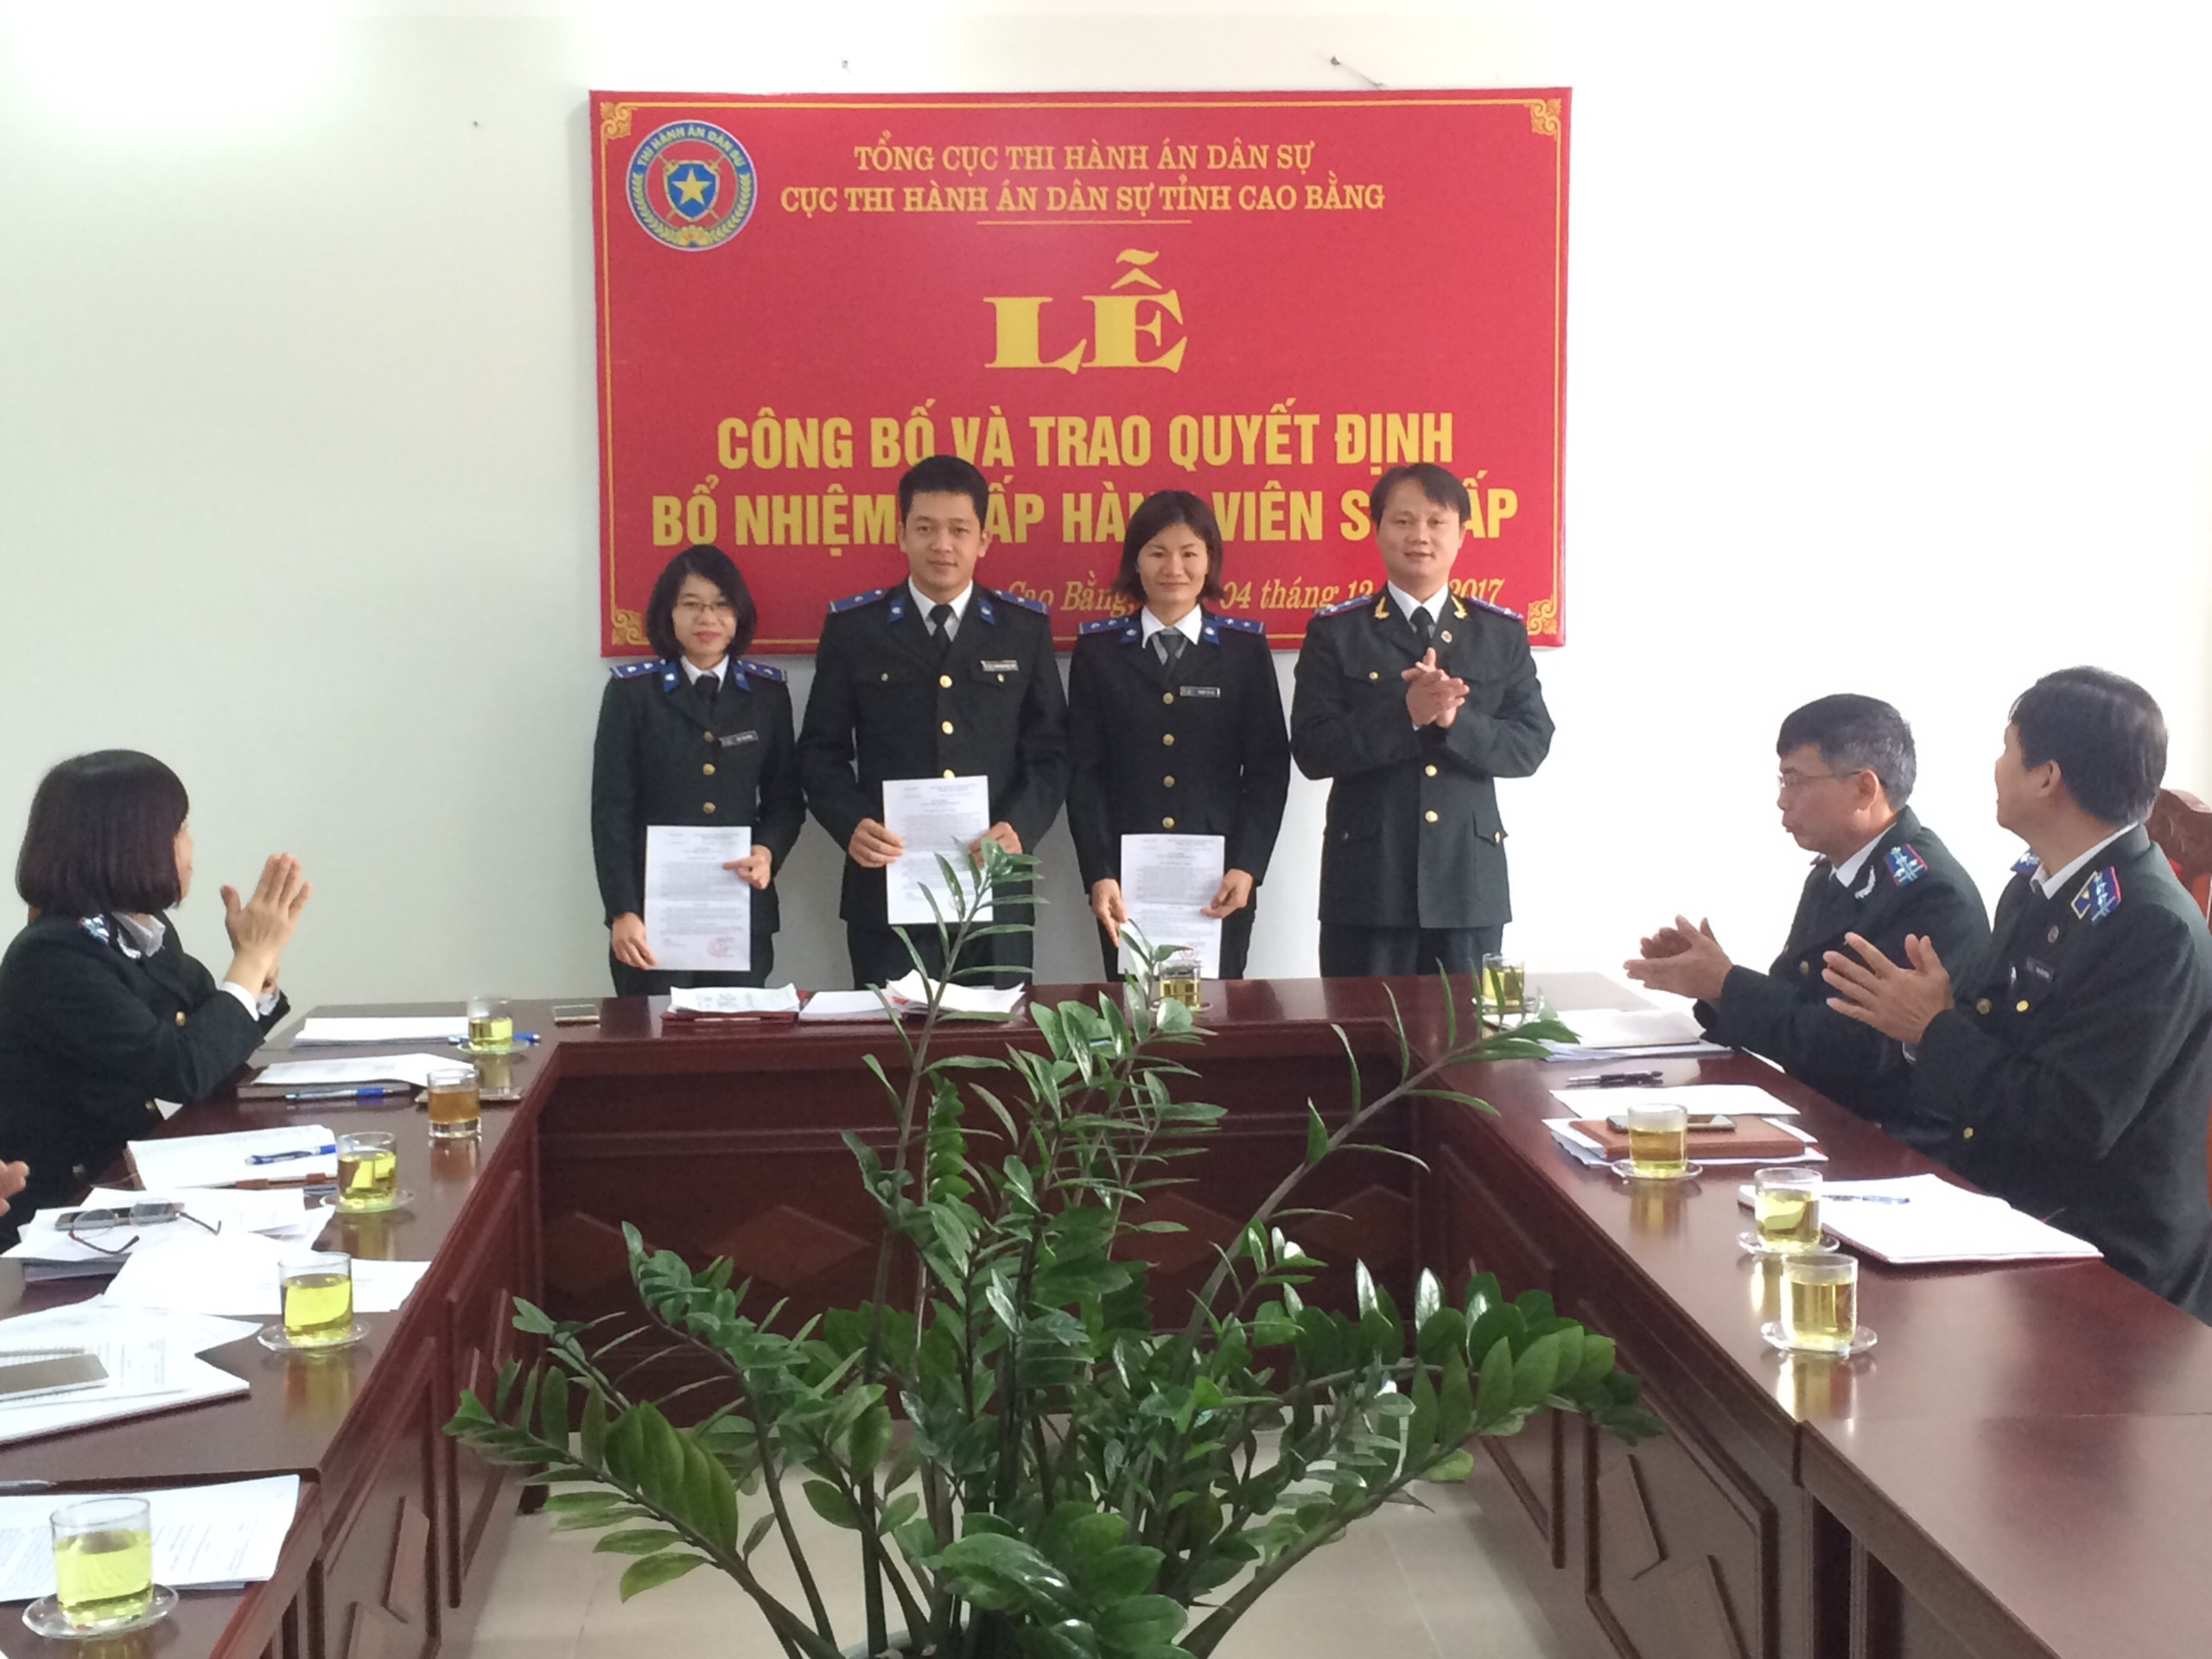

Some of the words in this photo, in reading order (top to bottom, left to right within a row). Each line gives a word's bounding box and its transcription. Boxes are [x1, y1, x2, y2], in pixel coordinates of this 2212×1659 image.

[638, 146, 654, 165] THI
[854, 130, 935, 171] TỔNG
[943, 145, 998, 176] CỤC
[1005, 145, 1055, 170] THI
[1064, 138, 1148, 170] HÀNH
[1158, 137, 1198, 169] ÁN
[1207, 137, 1268, 169] DÂN
[1277, 140, 1315, 175] SỰ
[781, 187, 837, 218] CỤC
[844, 187, 894, 212] THI
[903, 179, 988, 212] HÀNH
[996, 179, 1038, 212] ÁN
[1046, 178, 1108, 211] DÂN
[1116, 181, 1155, 217] SỰ
[1159, 174, 1231, 211] TỈNH
[1238, 185, 1296, 210] CAO
[1305, 170, 1385, 210] BẰNG
[982, 248, 1187, 375] LỄ
[717, 407, 854, 469] CÔNG
[870, 398, 936, 467] BỐ
[951, 405, 1014, 467] VÀ
[1029, 414, 1151, 467] TRAO
[1169, 398, 1319, 472] QUYẾT
[1335, 412, 1452, 475] ĐỊNH
[652, 474, 719, 546] BỔ
[734, 483, 896, 556] NHIỆM
[1212, 480, 1323, 542] VIÊN
[1340, 489, 1370, 541] S
[1462, 470, 1518, 538] ẤP
[1260, 575, 1339, 610] tháng
